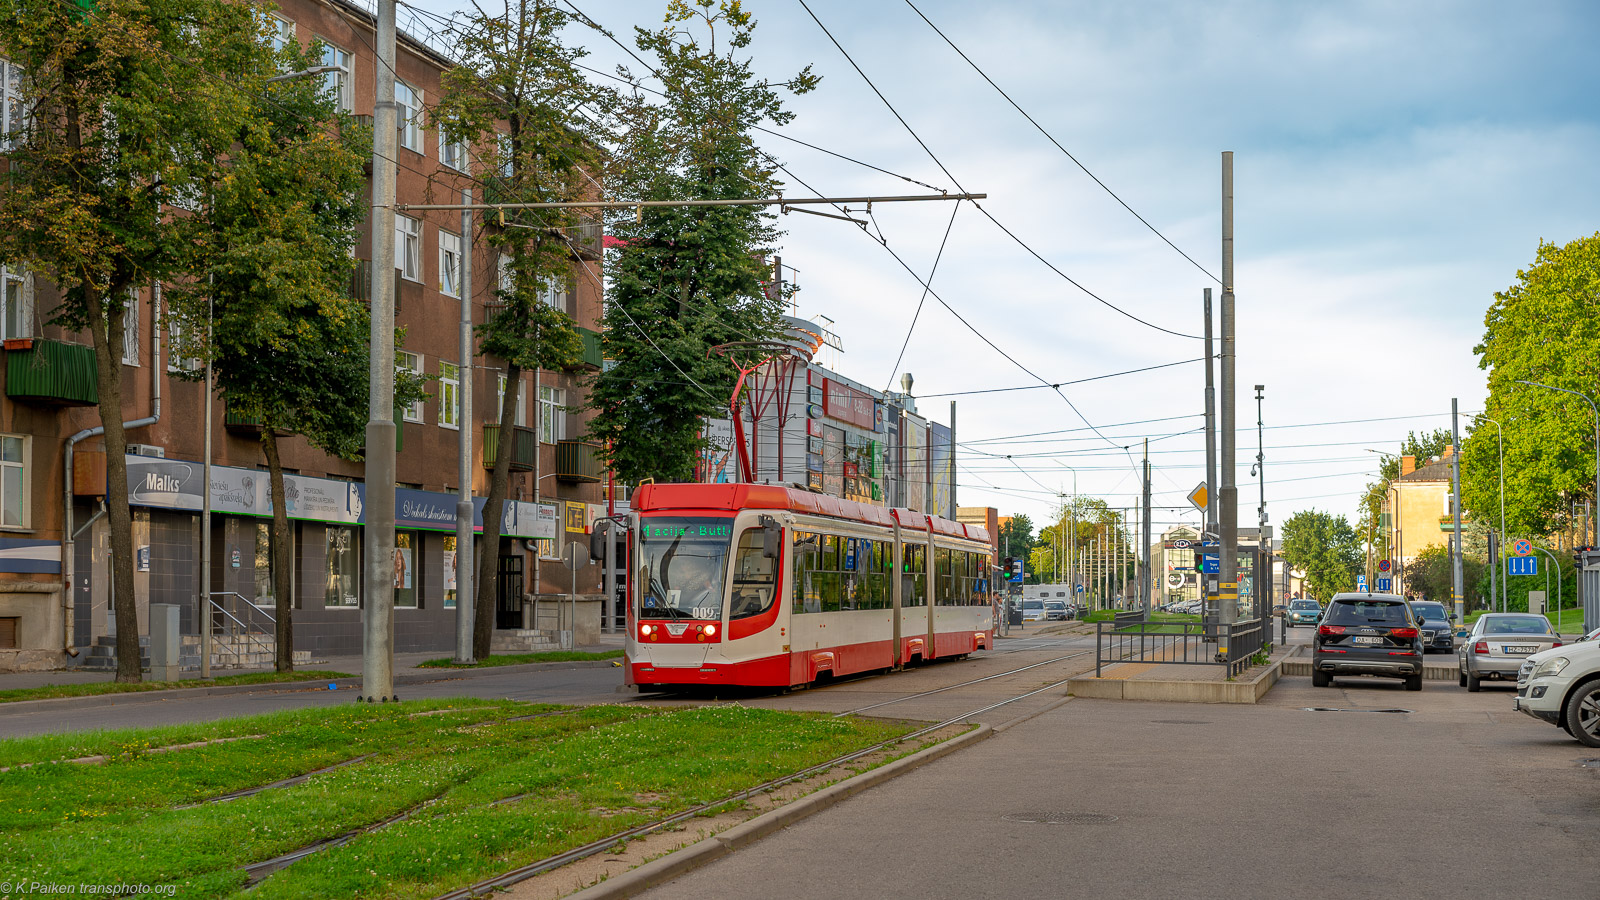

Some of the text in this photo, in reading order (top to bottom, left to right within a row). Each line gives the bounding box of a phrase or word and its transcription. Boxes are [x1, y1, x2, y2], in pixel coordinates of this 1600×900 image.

[146, 472, 180, 493] Malks
[642, 524, 650, 537] 1
[654, 526, 685, 537] acija
[670, 594, 677, 606] 1
[692, 607, 714, 619] 009
